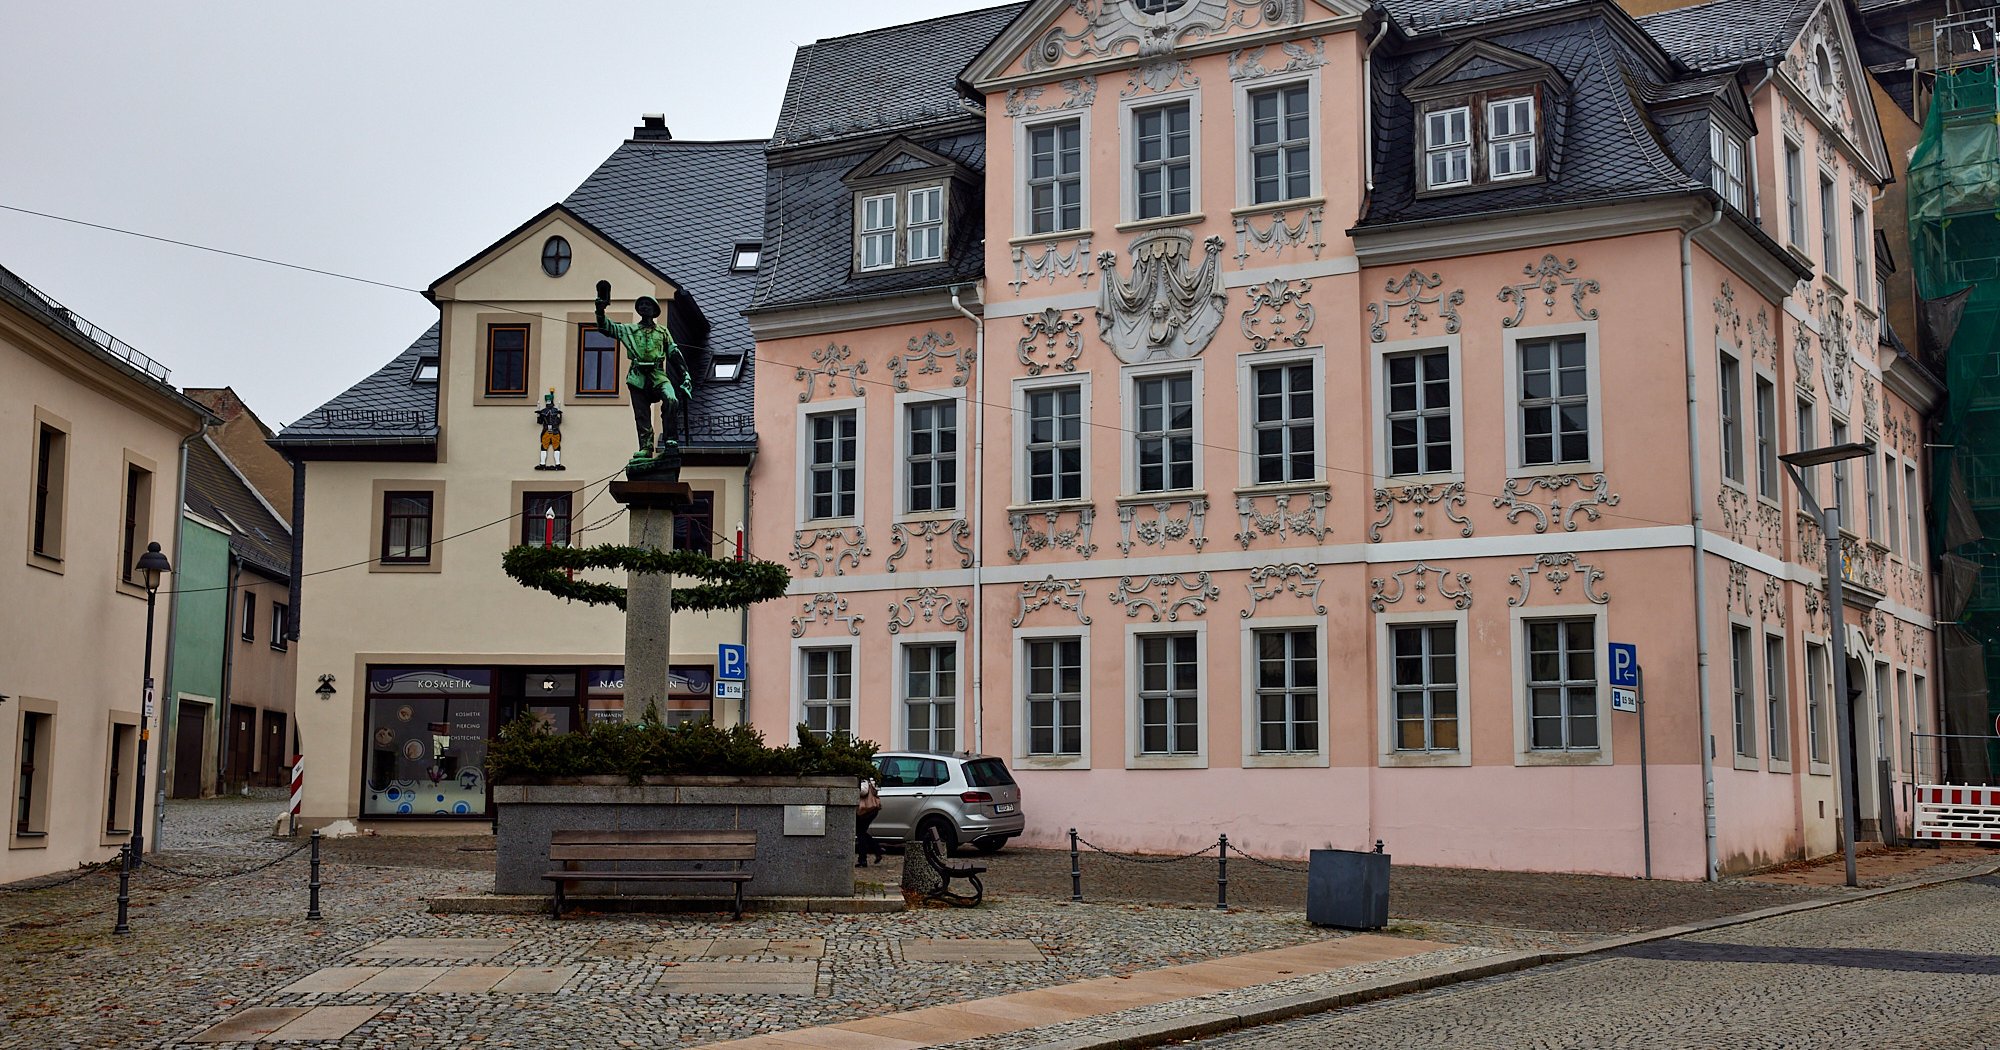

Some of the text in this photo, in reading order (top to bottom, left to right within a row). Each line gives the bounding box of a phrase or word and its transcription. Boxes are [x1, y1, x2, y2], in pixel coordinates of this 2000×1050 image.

[724, 648, 739, 674] P
[1615, 649, 1630, 680] P
[417, 680, 472, 688] KOSMETIK
